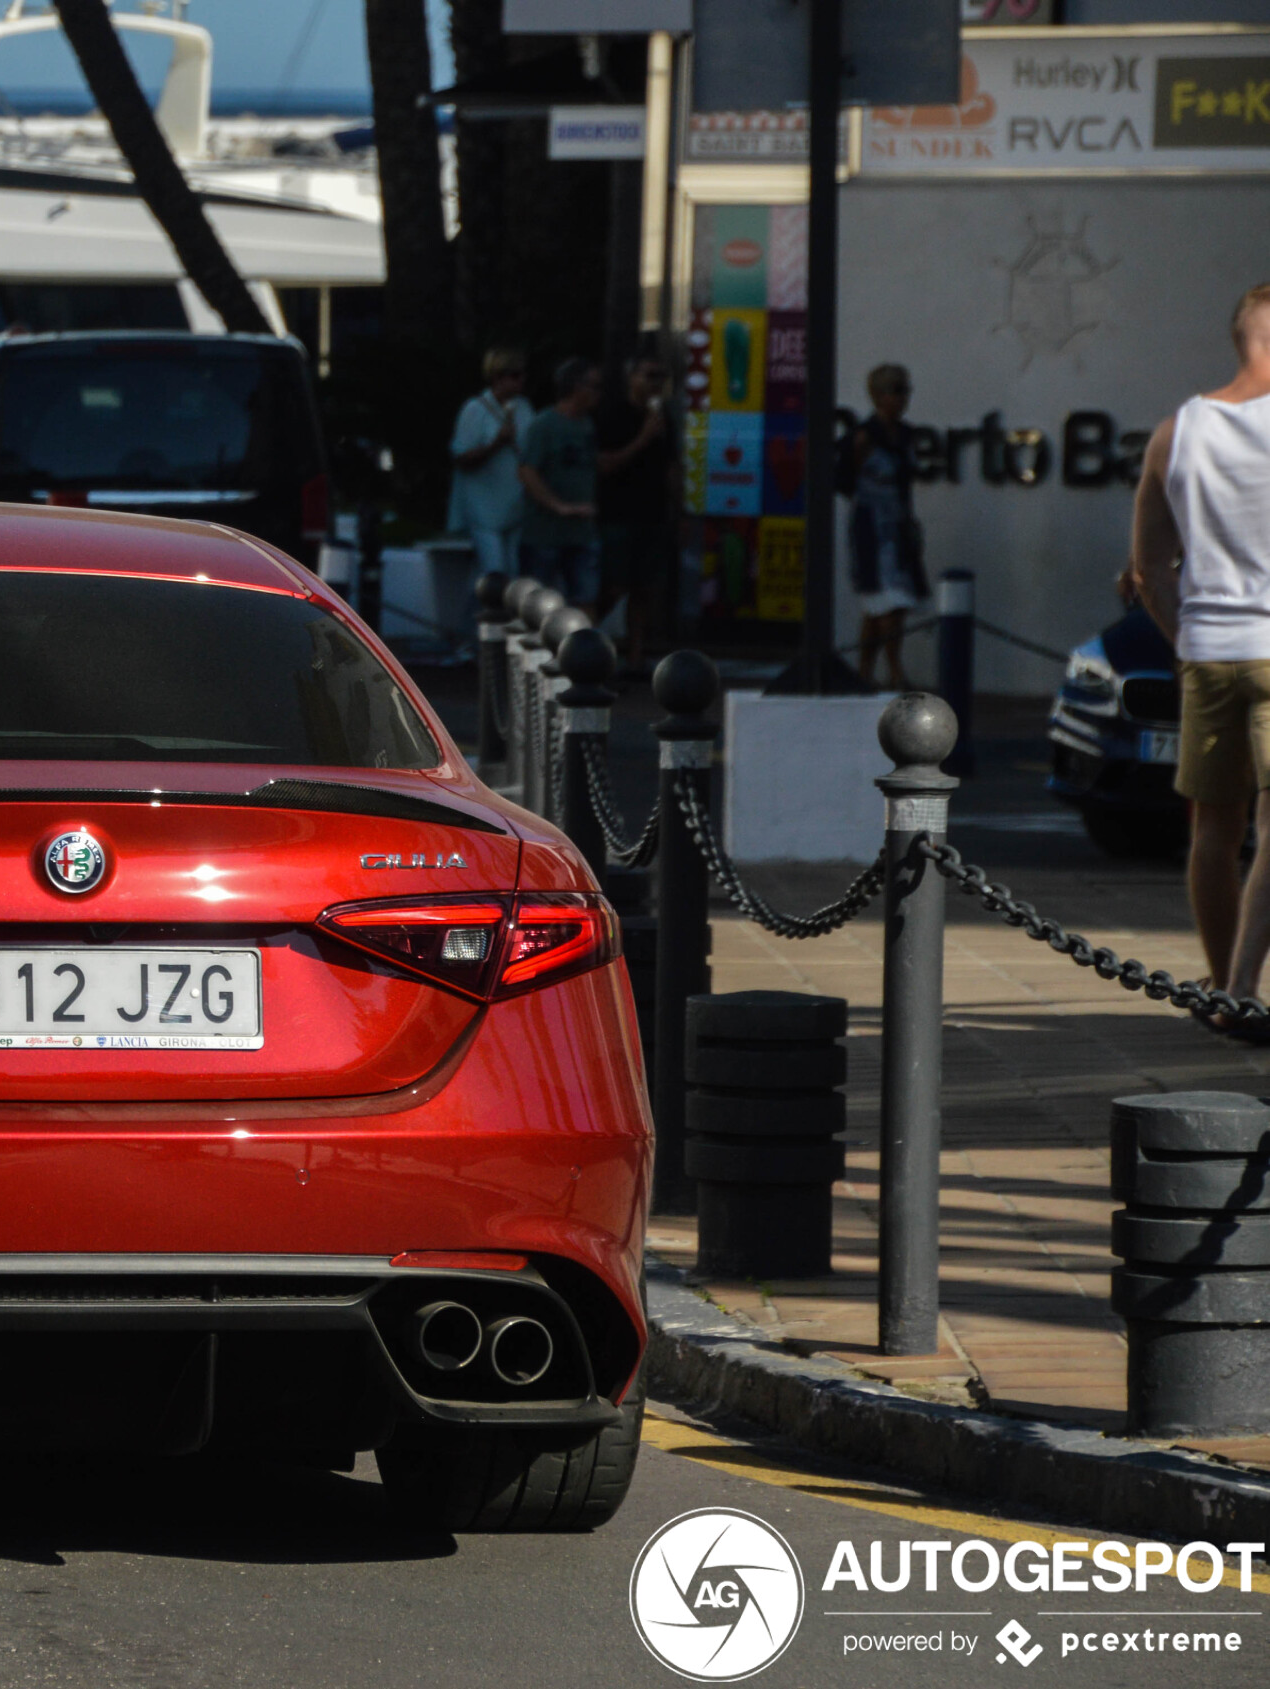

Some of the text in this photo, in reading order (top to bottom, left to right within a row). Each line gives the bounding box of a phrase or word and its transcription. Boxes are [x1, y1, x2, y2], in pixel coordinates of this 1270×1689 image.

[1012, 56, 1107, 91] Hurley
[1007, 115, 1142, 151] RVCA
[870, 137, 993, 159] SUNDEK
[833, 409, 1052, 485] erto
[50, 839, 69, 863] ALFA
[360, 852, 469, 869] GIULIA
[117, 963, 235, 1024] JZG
[110, 1036, 149, 1047] LANCIA
[159, 1037, 252, 1048] GIRONA OLOT
